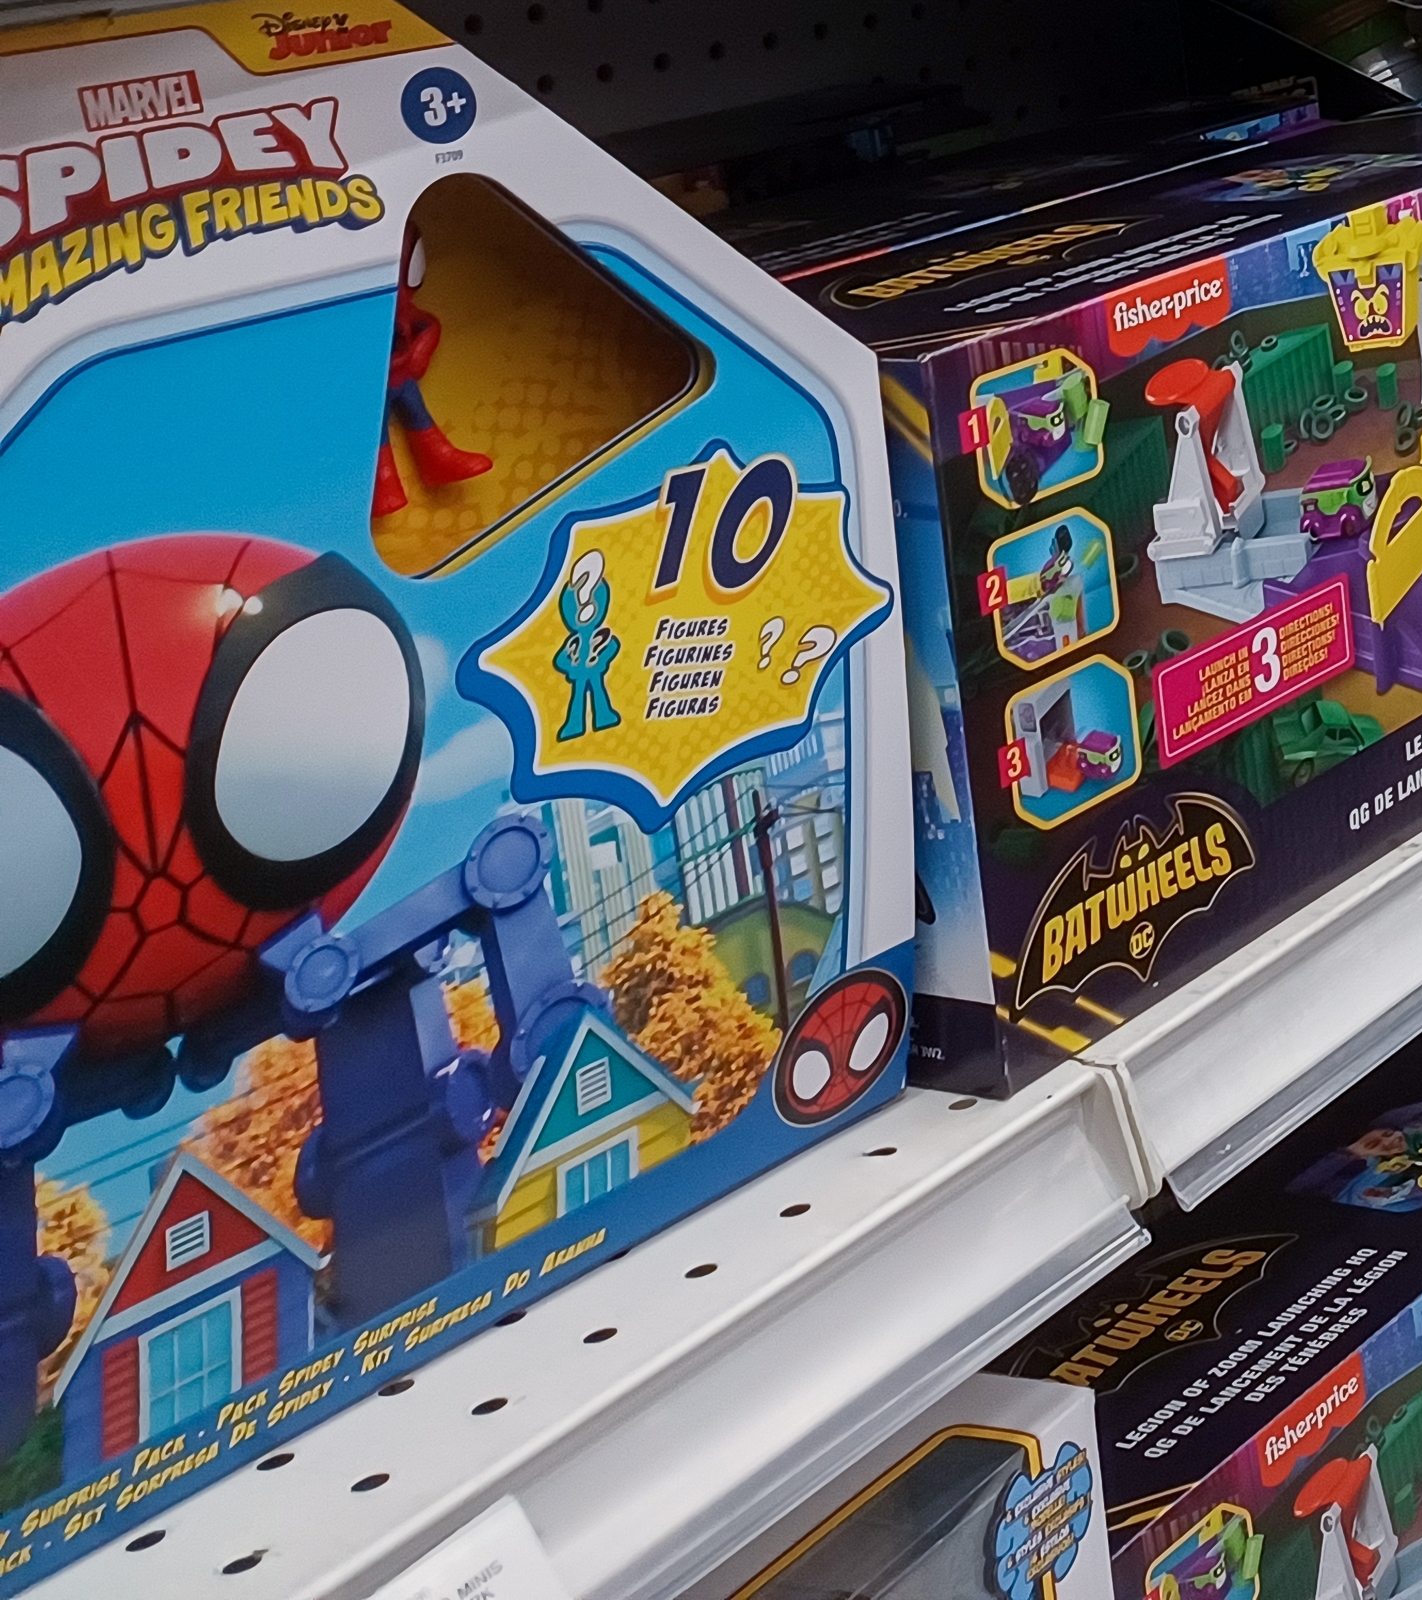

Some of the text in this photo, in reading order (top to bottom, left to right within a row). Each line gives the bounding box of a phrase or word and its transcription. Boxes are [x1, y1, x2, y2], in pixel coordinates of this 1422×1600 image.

[82, 75, 200, 129] MARVEL
[420, 86, 467, 127] 3+
[181, 178, 382, 251] FRIENDS
[1112, 278, 1224, 332] fisher-price
[655, 458, 793, 590] 10
[655, 617, 729, 641] FIGURES
[1279, 602, 1334, 640] DIRECTIONS!
[643, 642, 733, 668] FIGURINES
[1252, 626, 1282, 694] 3
[1281, 629, 1336, 668] DIRECTIONS!
[649, 669, 723, 694] FIGUREN
[645, 696, 720, 721] FIGURAS
[1187, 689, 1225, 718] LANCEZ
[1005, 746, 1024, 777] 3
[1349, 803, 1370, 831] QG
[1374, 786, 1394, 816] DE
[1041, 823, 1233, 986] BATWHEELS
[1128, 920, 1156, 960] DC
[1115, 1247, 1379, 1450] LEGION OF ZOOM LAUNCHING HQ
[1166, 1319, 1203, 1341] DC
[229, 1269, 531, 1449] DE SPIDEY KIT DO
[1144, 1249, 1409, 1460] QG DE LANCEMENT DE LA LÉGION
[1244, 1373, 1288, 1404] DES
[21, 1297, 440, 1537] SURPRISE PACK PACK SPIDEY SURPRISE
[1264, 1375, 1361, 1466] fisher-price
[456, 1558, 504, 1600] MINIS
